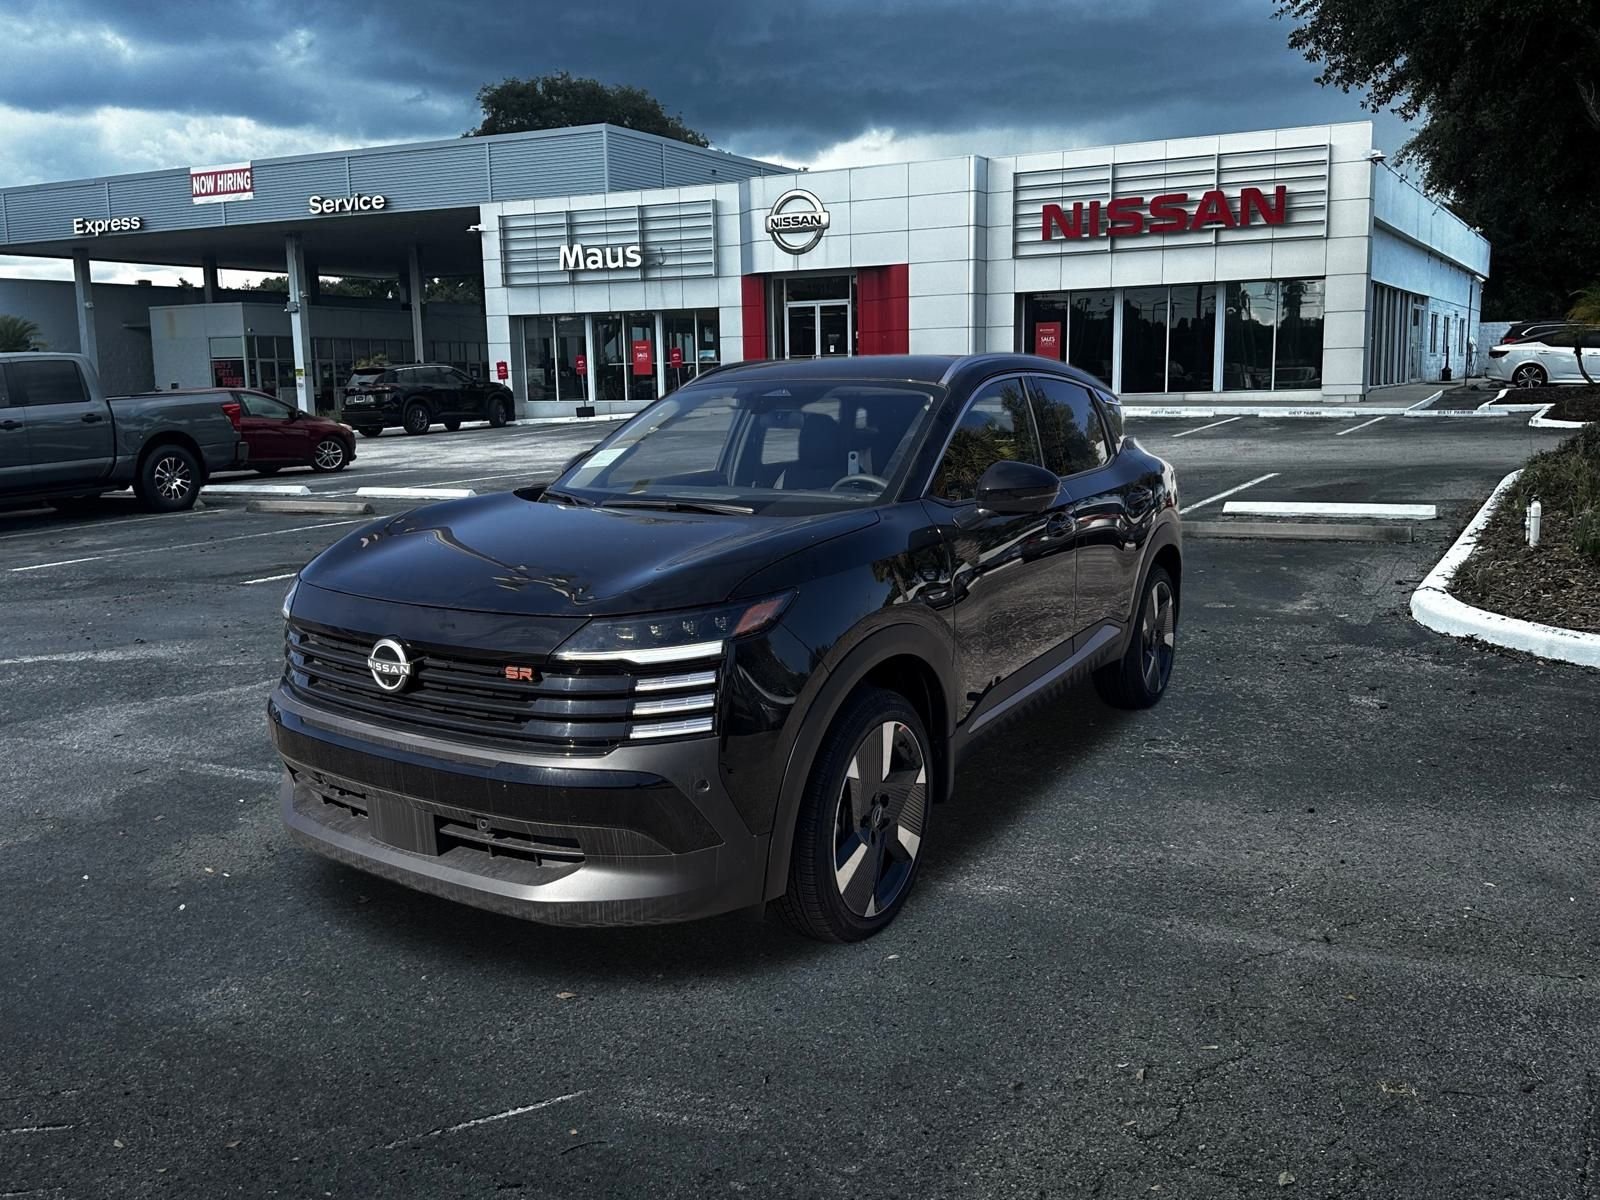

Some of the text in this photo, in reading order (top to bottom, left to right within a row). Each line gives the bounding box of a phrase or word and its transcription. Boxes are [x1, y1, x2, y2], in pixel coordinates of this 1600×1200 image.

[193, 171, 251, 195] NOW HIRING
[309, 193, 385, 215] Service
[1042, 185, 1287, 241] NISSAN
[73, 216, 141, 236] Express
[770, 215, 822, 228] NISSAN
[559, 243, 642, 271] Maus
[367, 658, 409, 674] NISSAN
[504, 665, 533, 681] SR
